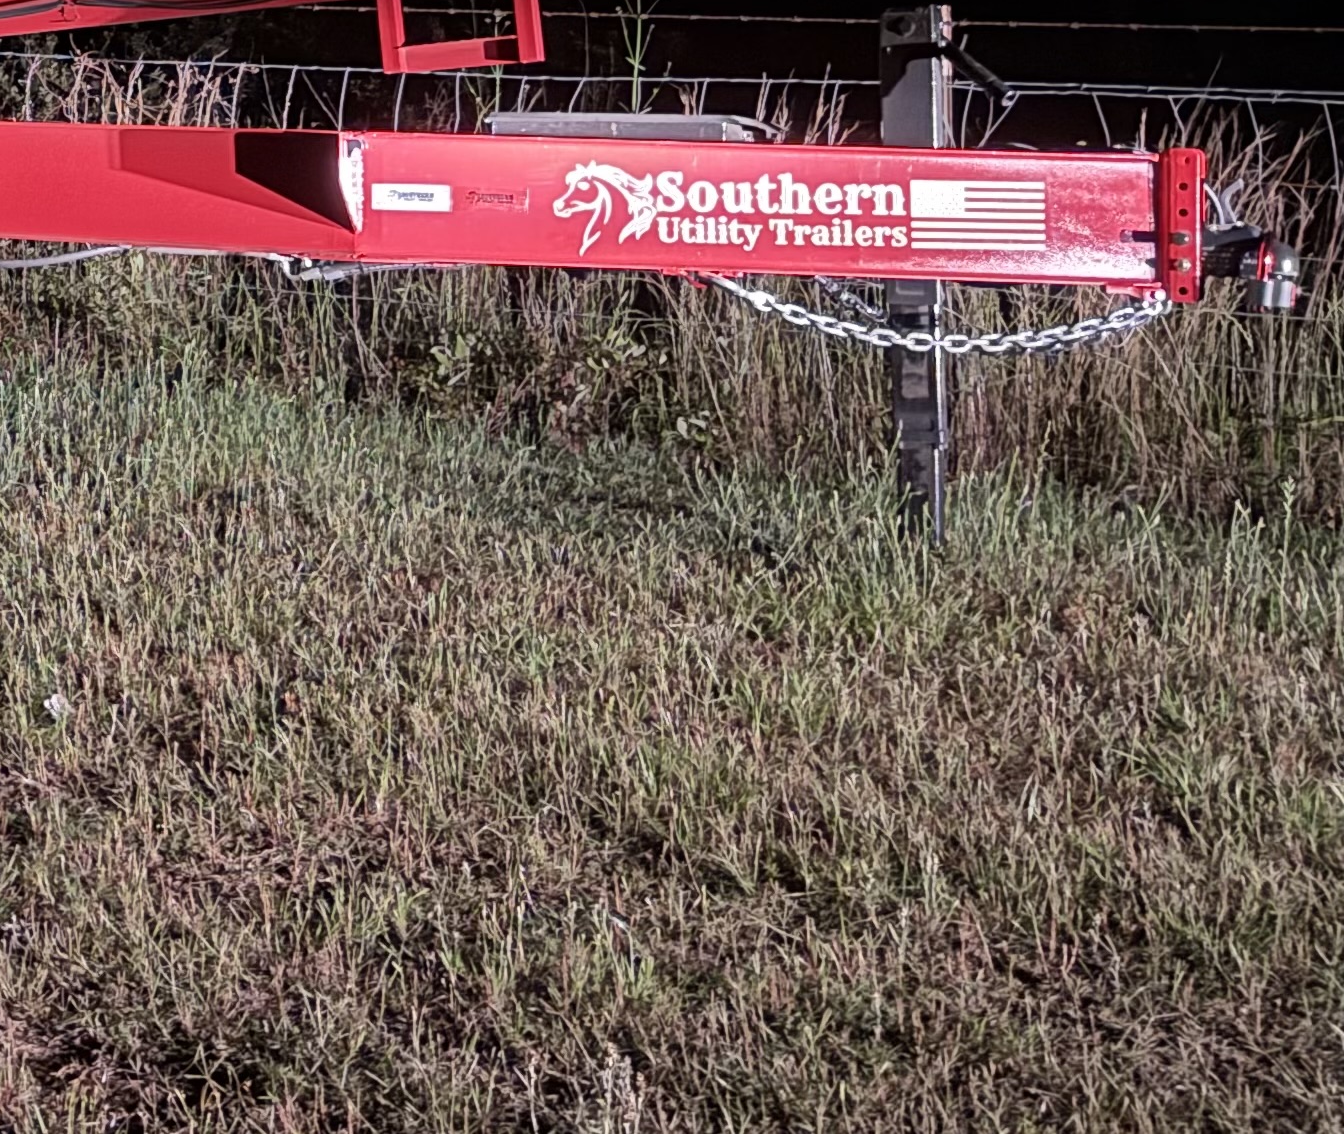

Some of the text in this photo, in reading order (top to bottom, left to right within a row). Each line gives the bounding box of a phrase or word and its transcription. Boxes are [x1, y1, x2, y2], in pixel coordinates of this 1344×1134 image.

[656, 170, 906, 216] Southern
[658, 216, 908, 251] Utility Trailers
